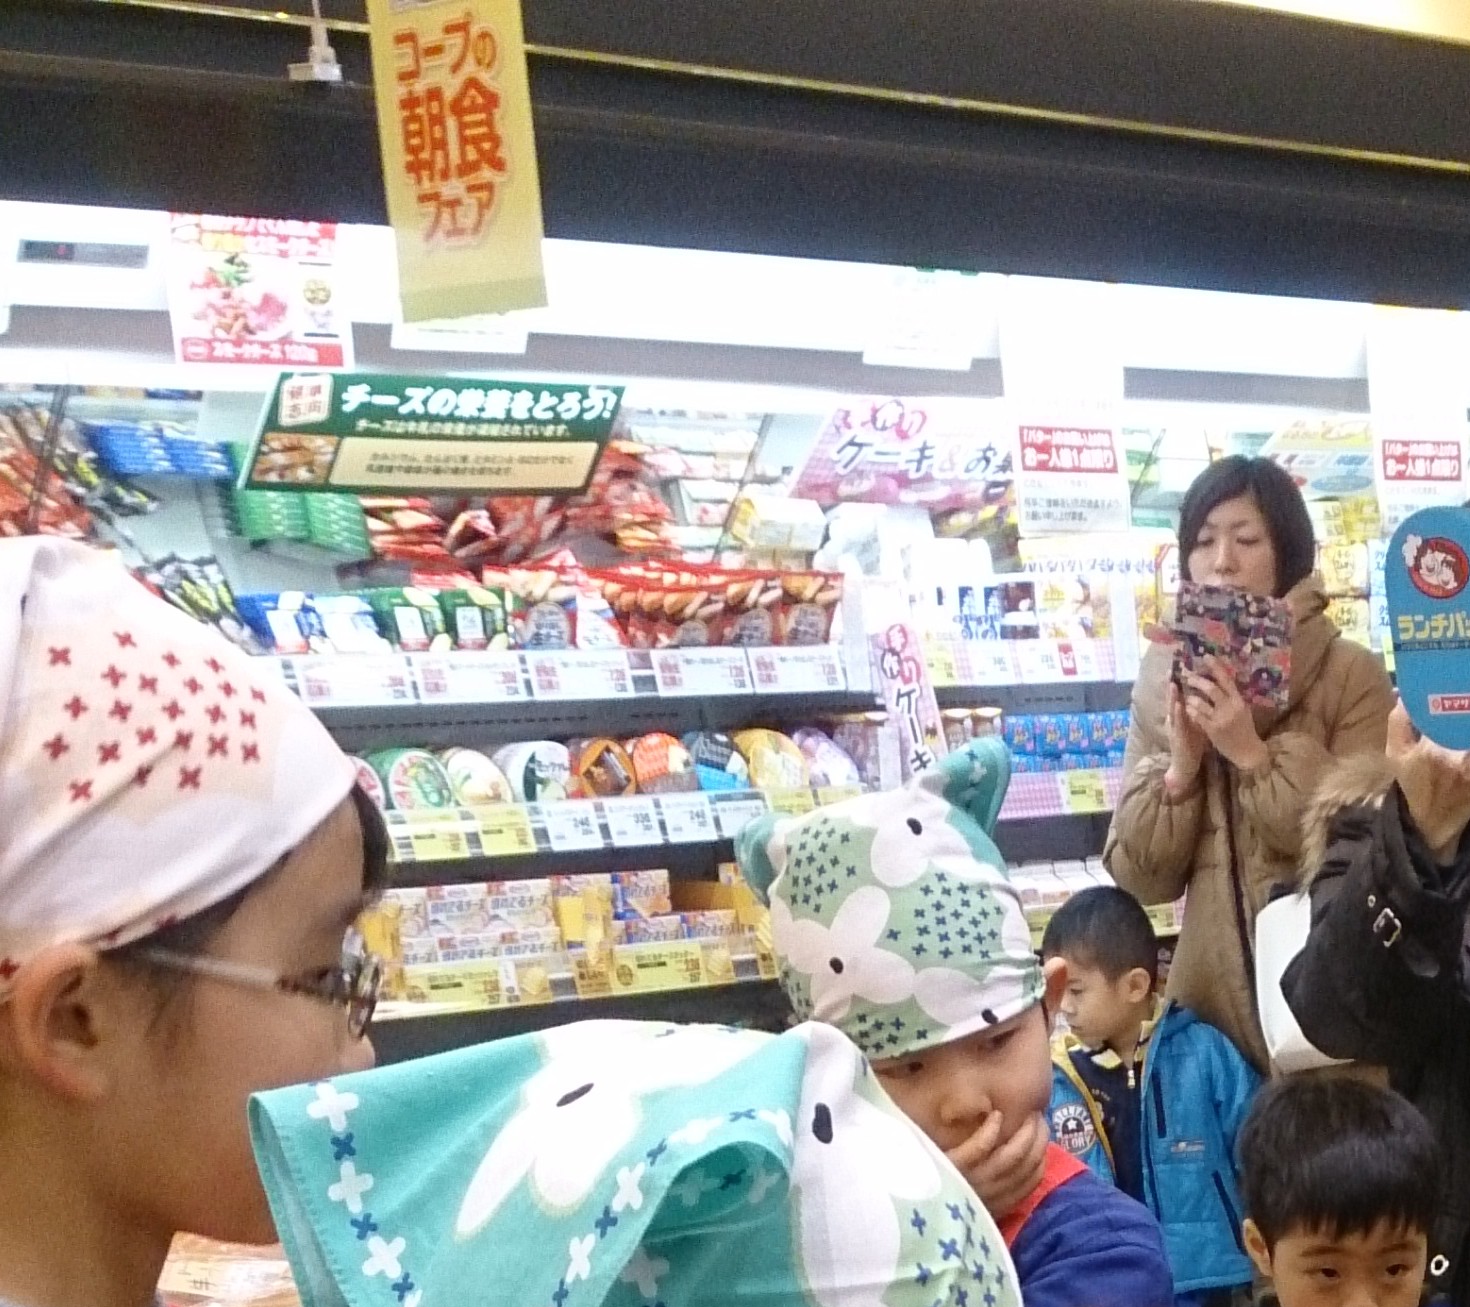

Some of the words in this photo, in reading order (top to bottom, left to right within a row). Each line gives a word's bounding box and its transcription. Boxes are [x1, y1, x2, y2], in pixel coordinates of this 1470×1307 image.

[393, 12, 497, 81] コープの
[399, 76, 507, 185] 朝食
[417, 181, 496, 242] フェア
